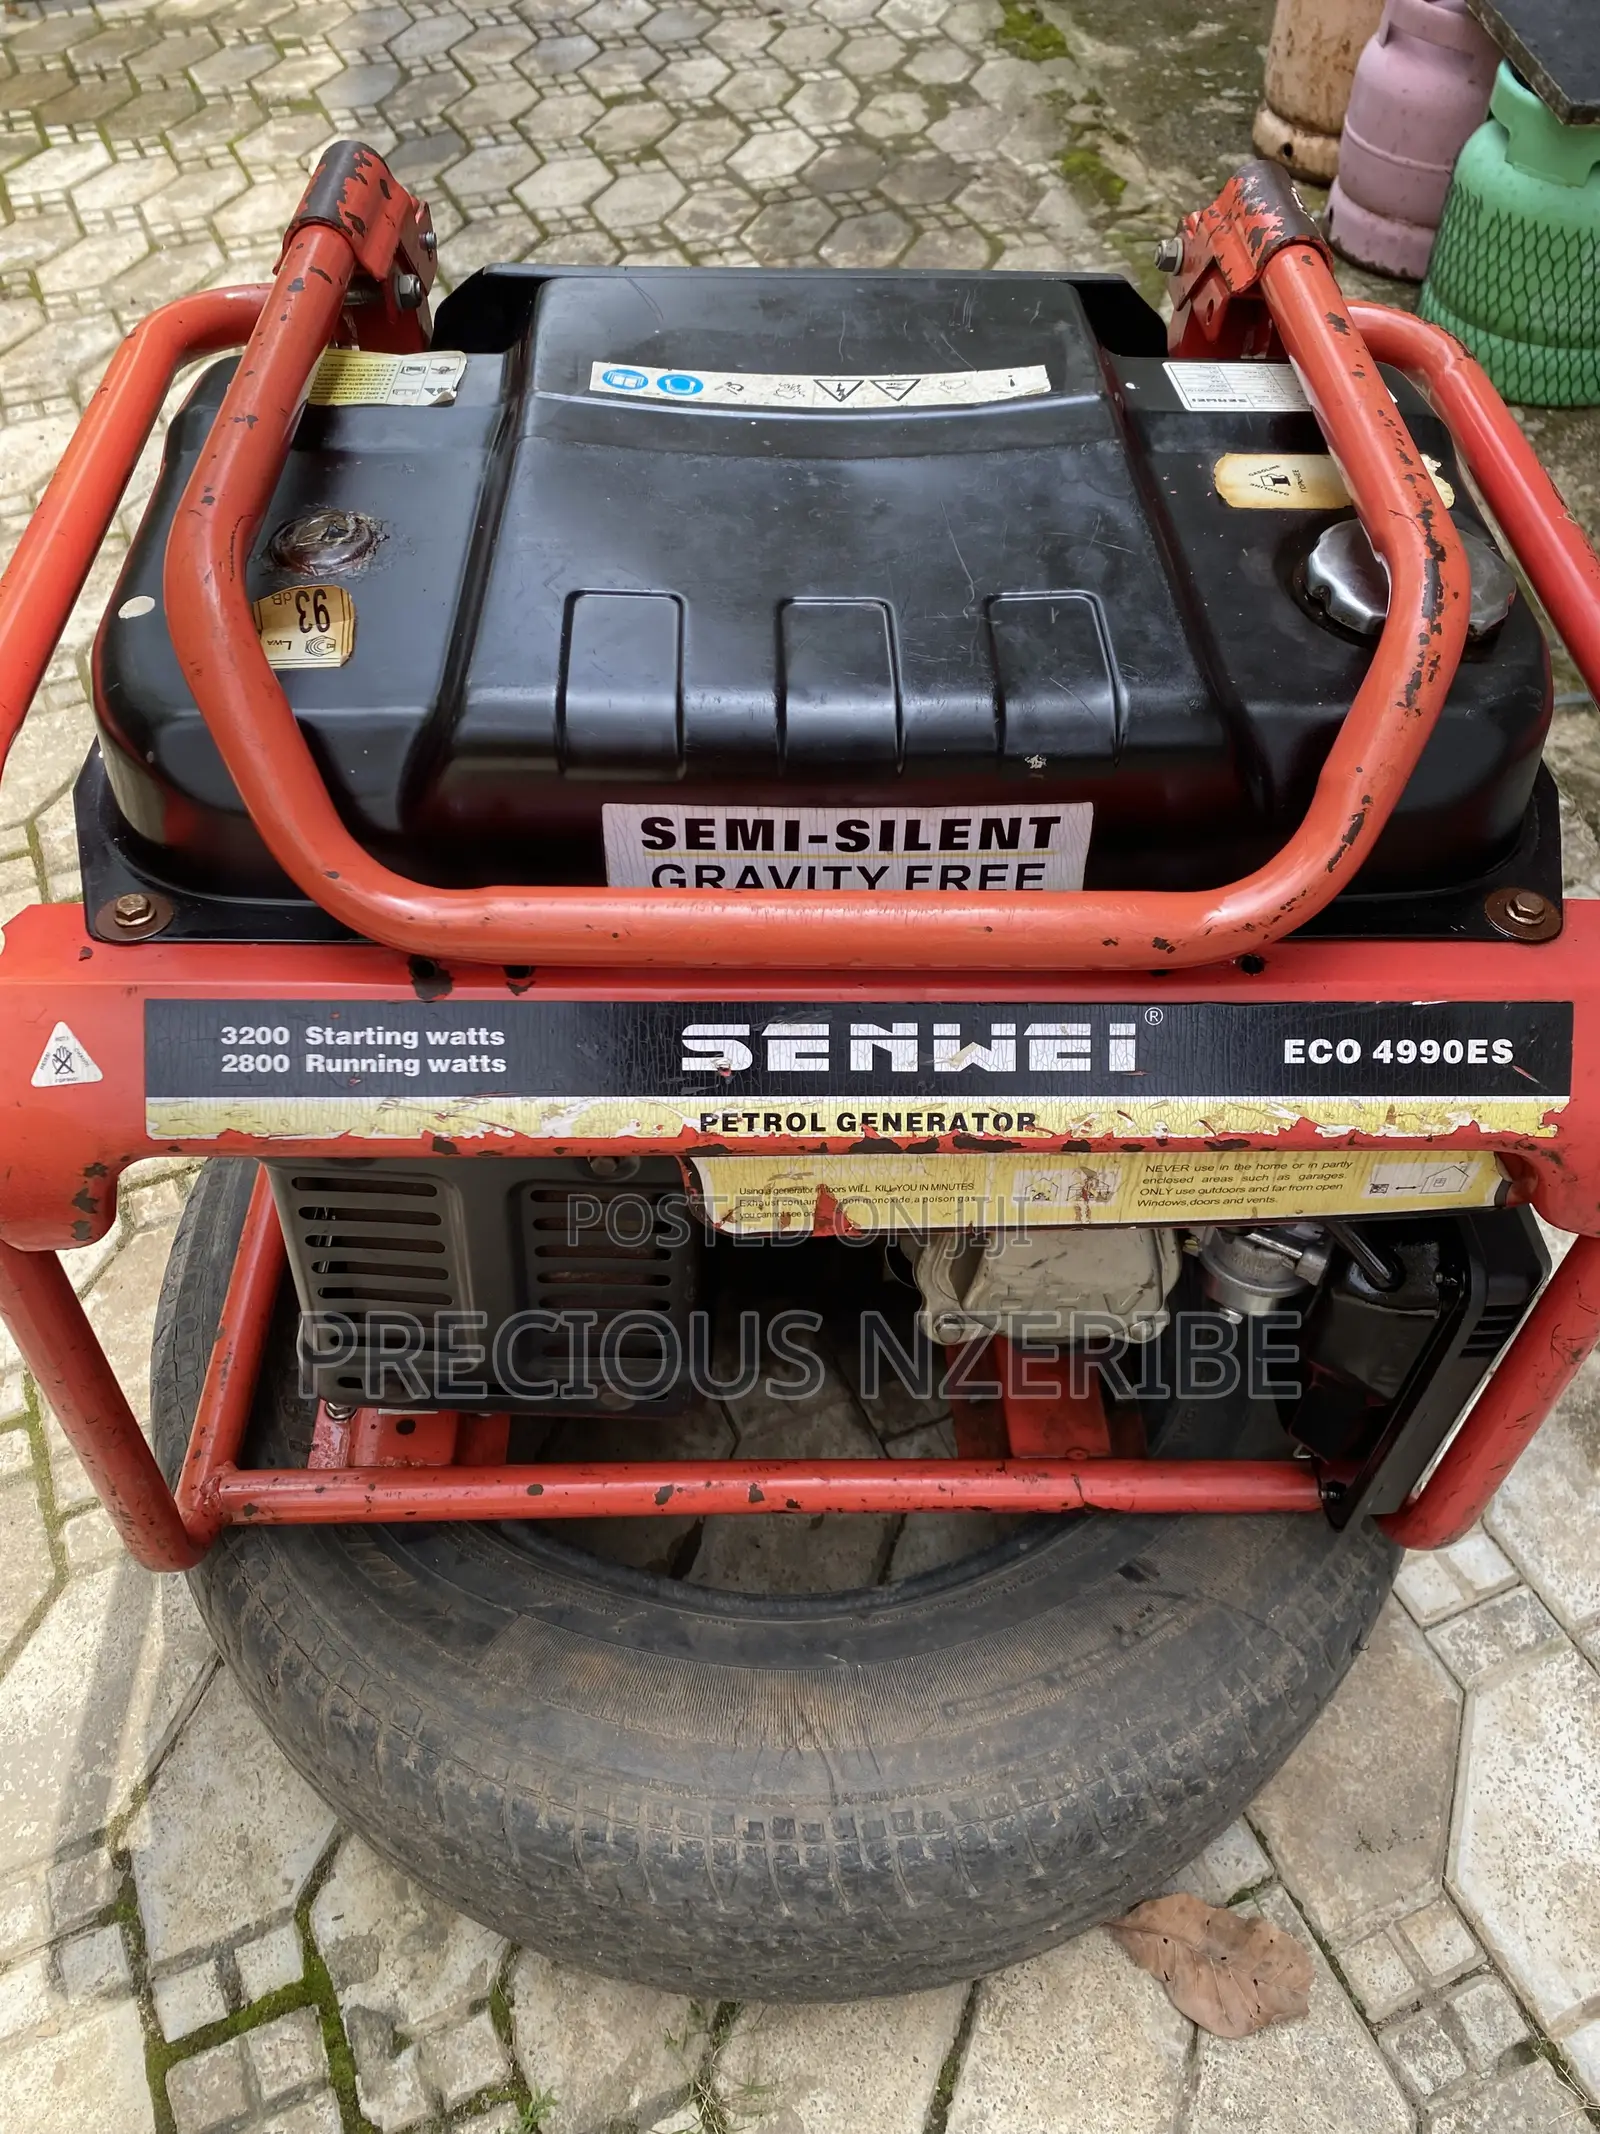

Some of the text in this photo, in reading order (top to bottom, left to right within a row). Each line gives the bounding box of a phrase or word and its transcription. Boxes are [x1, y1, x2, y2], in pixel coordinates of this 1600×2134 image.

[271, 588, 331, 634] 93 dB
[640, 816, 1062, 853] SEMI-SILENT
[651, 863, 1046, 891] GRAVITY FREE
[220, 1026, 506, 1049] 3200 Starting watts
[681, 1023, 1137, 1072] SENWEI
[1284, 1038, 1514, 1065] ECO 4990ES
[221, 1054, 507, 1077] 2800 Running watts
[700, 1112, 1037, 1133] PETROL GENERATOR
[1145, 1165, 1190, 1173] NEVER
[1234, 1163, 1252, 1171] the
[1256, 1162, 1288, 1170] home
[1292, 1162, 1305, 1170] or
[1308, 1161, 1318, 1169] in
[1322, 1160, 1353, 1170] partly
[739, 1187, 764, 1196] Using
[773, 1186, 814, 1196] generator
[849, 1184, 870, 1193] WILL
[875, 1184, 895, 1193] KILL
[896, 1183, 918, 1192] YOU
[919, 1183, 929, 1191] IN
[931, 1182, 975, 1191] MINUTES
[1140, 1187, 1174, 1196] ONLY
[1197, 1186, 1246, 1195] outdoors
[1248, 1184, 1270, 1193] and
[1271, 1184, 1287, 1192] far
[1288, 1183, 1314, 1192] from
[1315, 1183, 1344, 1193] open
[1142, 1176, 1194, 1184] enclosed
[1241, 1174, 1269, 1182] such
[739, 1199, 779, 1207] Exhaust
[922, 1195, 956, 1204] poison
[1222, 1197, 1244, 1205] and
[739, 1212, 755, 1221] you
[756, 1210, 785, 1219] cannot
